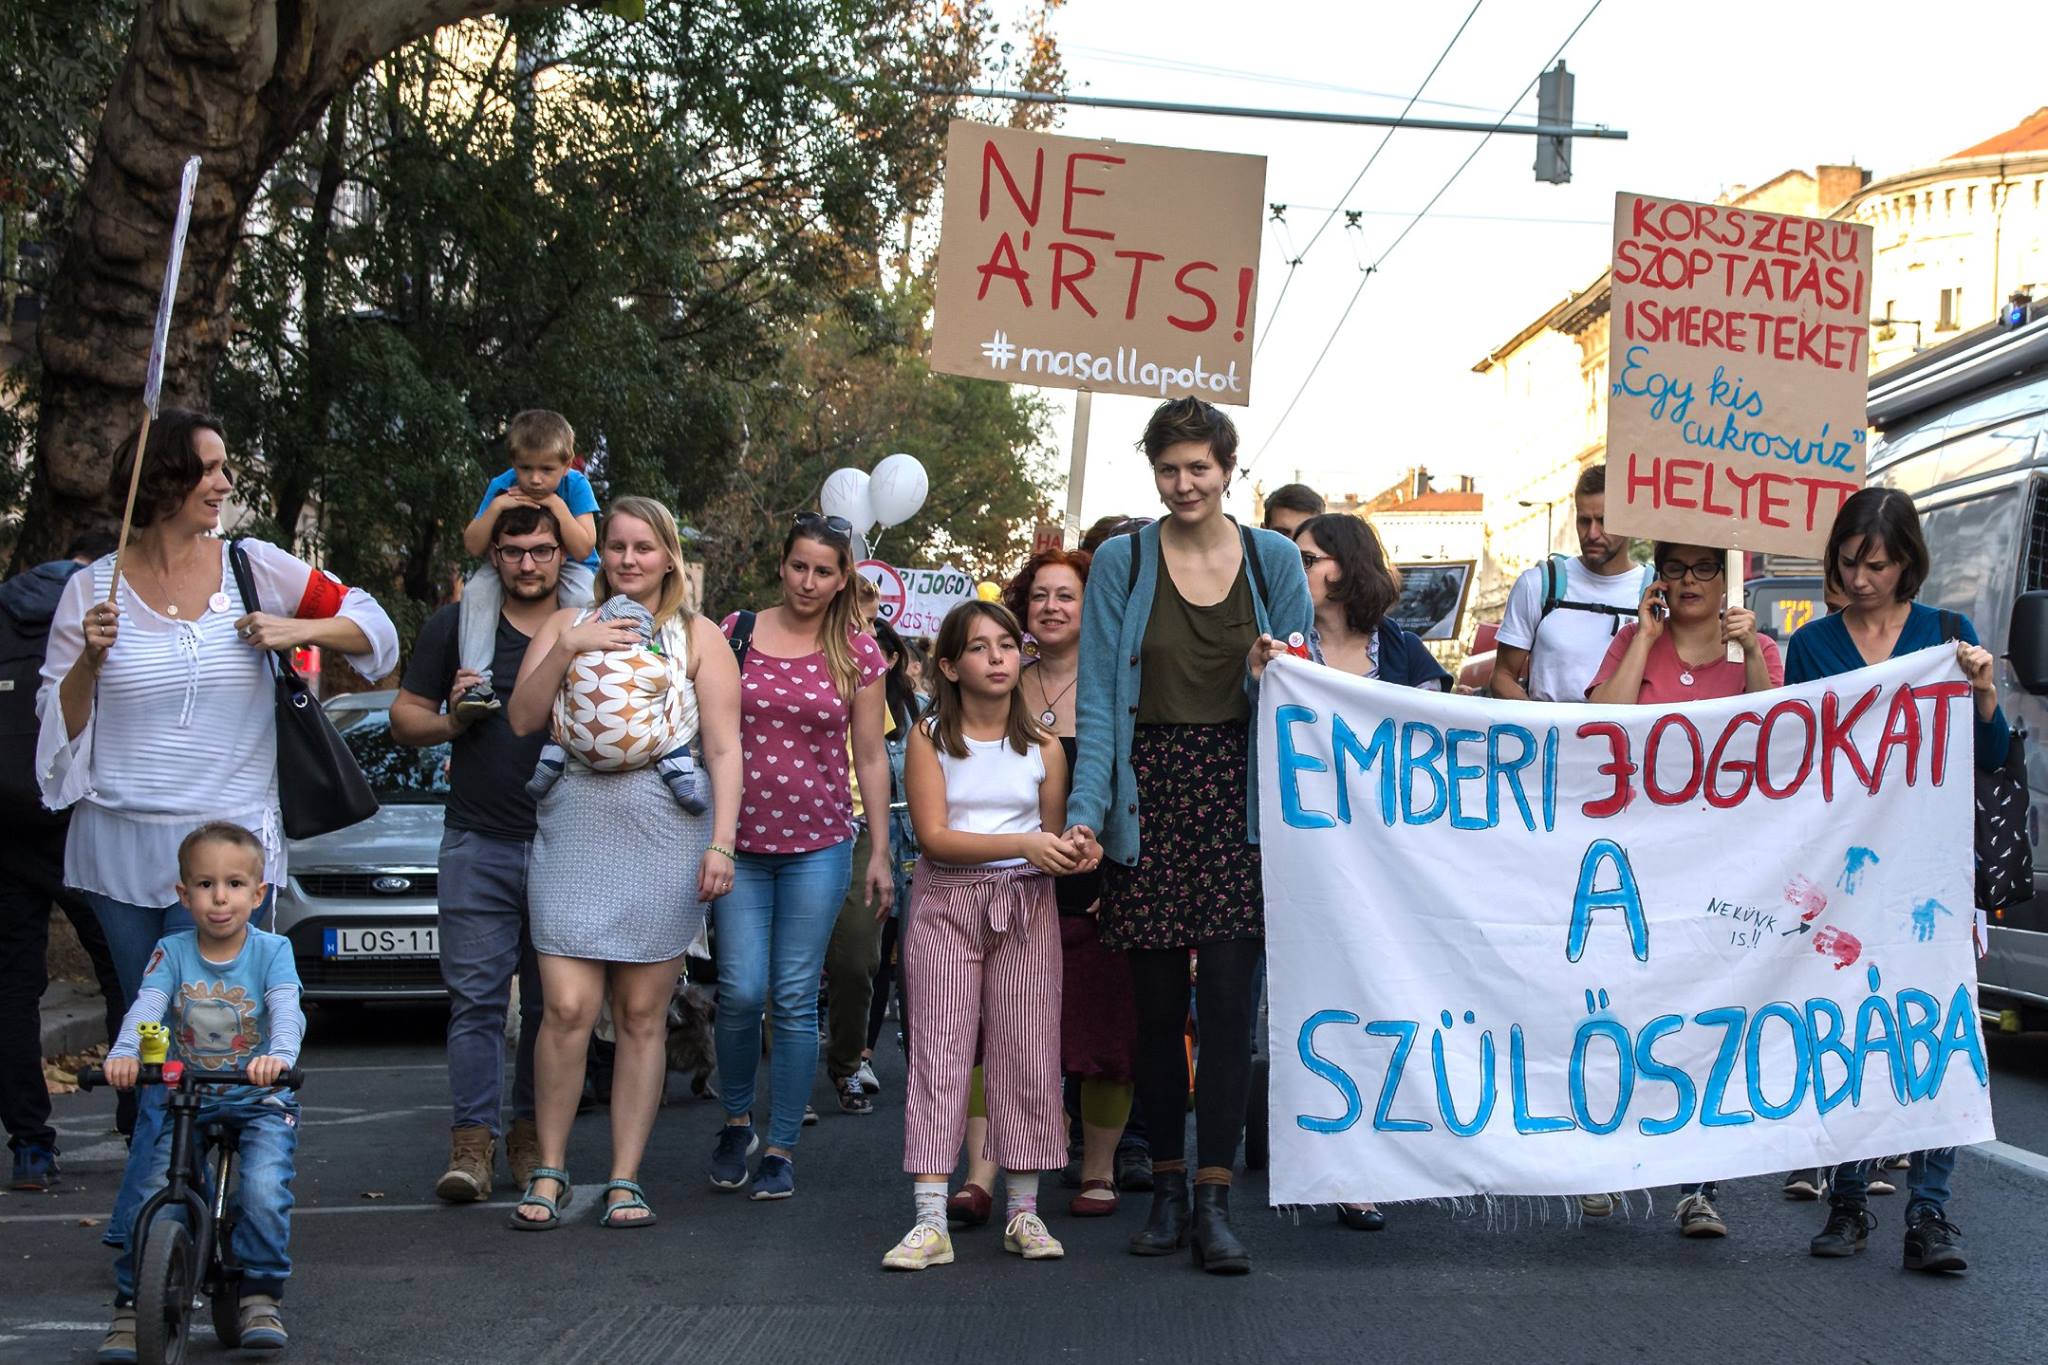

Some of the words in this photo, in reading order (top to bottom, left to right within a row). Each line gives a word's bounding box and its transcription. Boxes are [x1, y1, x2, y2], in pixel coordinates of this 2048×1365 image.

[980, 140, 1126, 240] NE
[977, 231, 1253, 342] ÁRTS!
[980, 330, 1241, 395] #masallapotot
[1625, 300, 1867, 372] ISMERETEKET
[1708, 366, 1763, 417] kis
[1276, 704, 1558, 832] EMBERI
[1575, 681, 1972, 817] JOGOKAT
[1566, 838, 1649, 963] A
[1707, 897, 1777, 933] NEKÜNK
[343, 930, 434, 953] LOS-11
